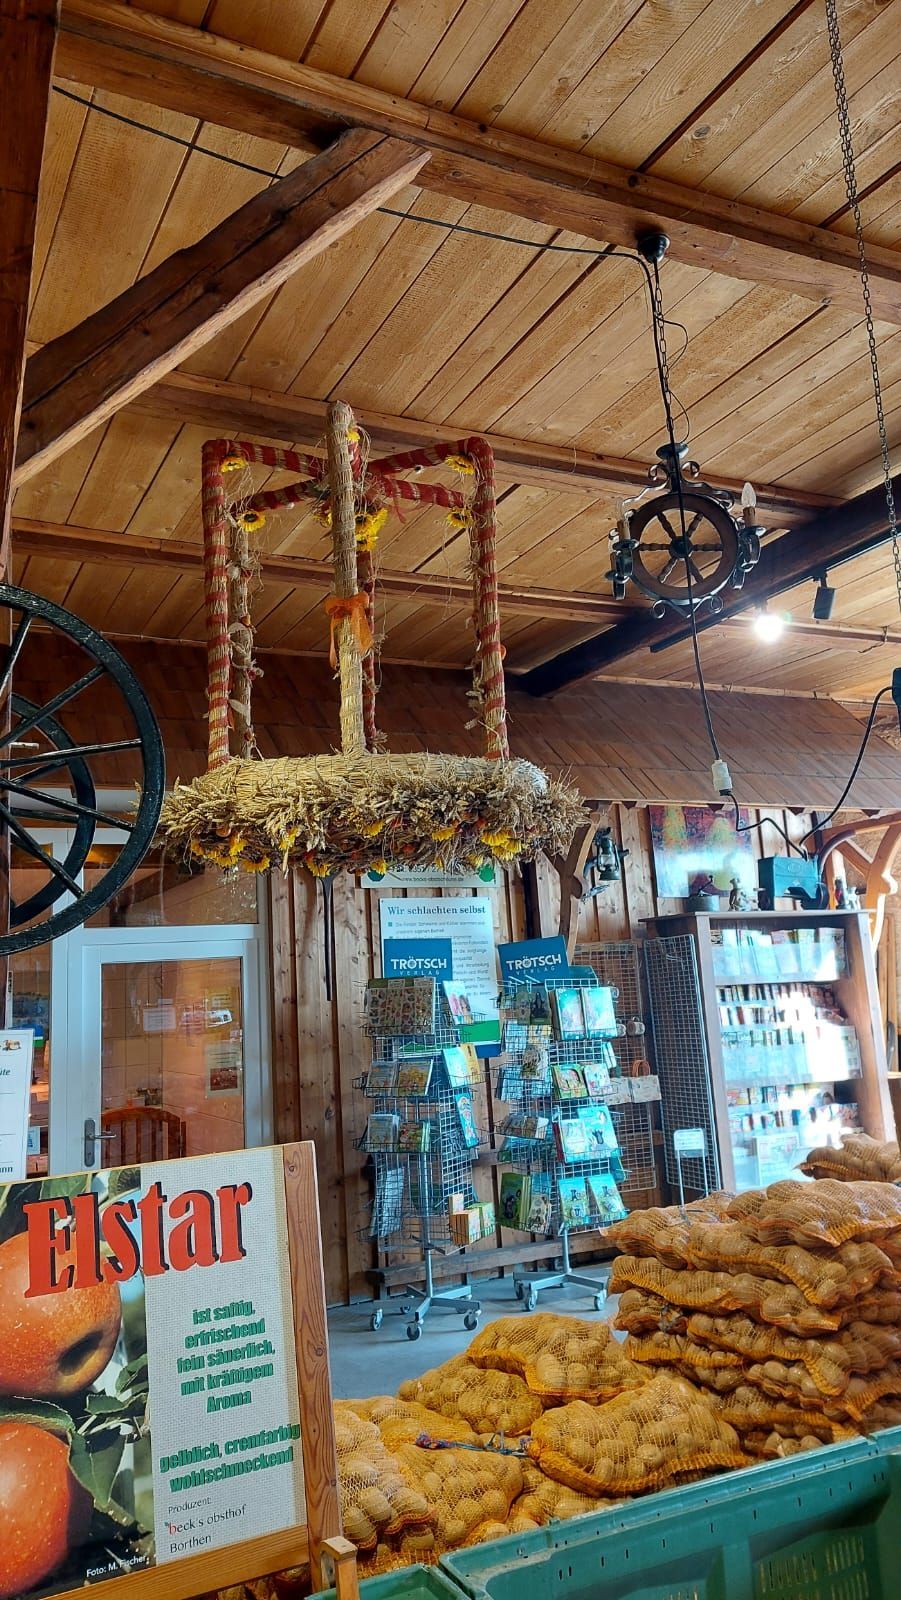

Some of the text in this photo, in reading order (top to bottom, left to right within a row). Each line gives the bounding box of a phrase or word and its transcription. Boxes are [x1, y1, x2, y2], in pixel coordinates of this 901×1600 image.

[387, 905, 486, 915] Wir schlachten selbst
[390, 955, 447, 970] TRÖTSCH
[505, 953, 562, 971] TRÖTSCH
[22, 1181, 253, 1299] Elstar
[192, 1299, 256, 1325] ist saftig,
[184, 1317, 266, 1349] erfrischend
[176, 1339, 276, 1374] fein säuerlich,
[180, 1362, 274, 1396] mit kräftigem
[206, 1390, 252, 1414] Aroma
[159, 1423, 301, 1473] gelblich, cremfarbig
[169, 1446, 294, 1493] wohlschmeckend
[168, 1496, 213, 1515] Produzent:
[206, 1503, 247, 1525] obsthof
[169, 1534, 212, 1553] Borthen
[86, 1566, 107, 1578] Foto:
[108, 1561, 119, 1572] M.
